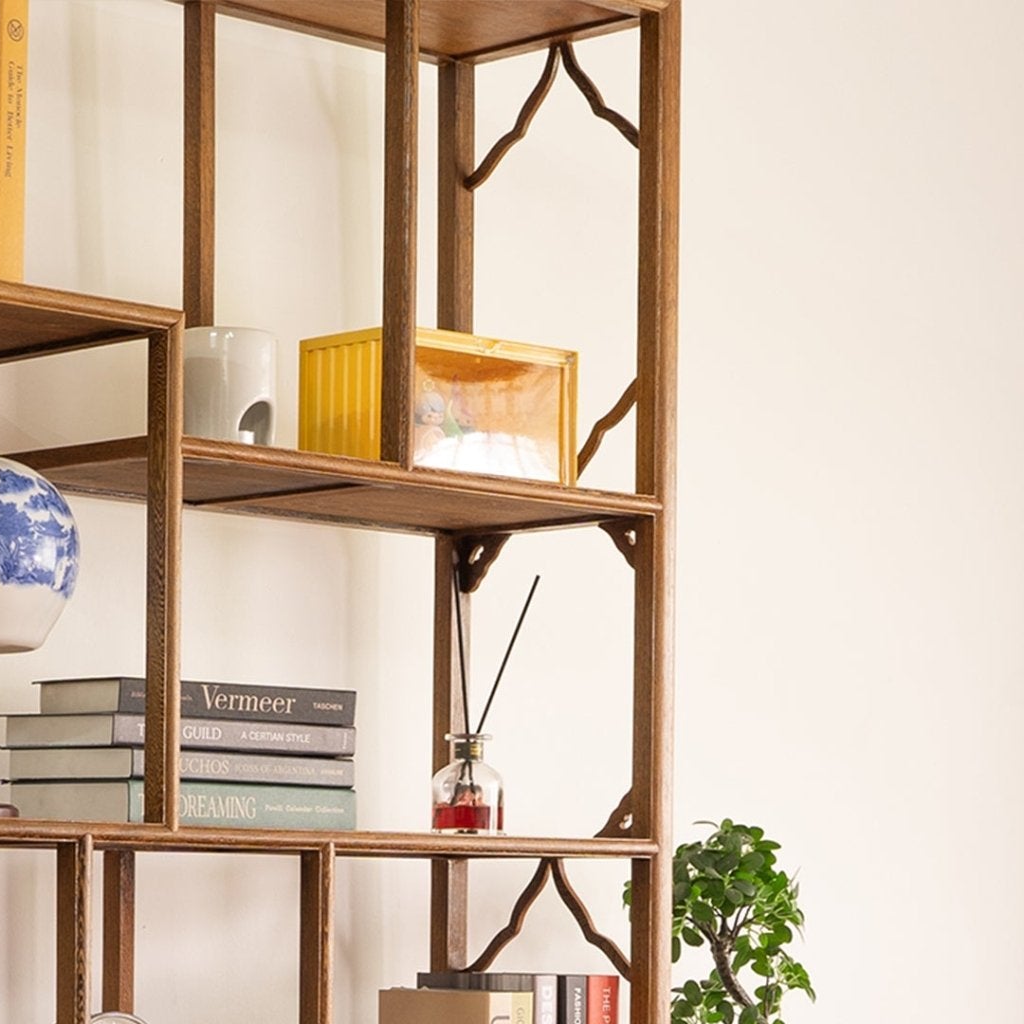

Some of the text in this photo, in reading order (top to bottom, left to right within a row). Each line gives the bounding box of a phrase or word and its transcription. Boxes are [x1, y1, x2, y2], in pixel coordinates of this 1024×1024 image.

[7, 60, 15, 91] Guide
[8, 94, 15, 105] to
[4, 145, 14, 178] Living
[201, 684, 344, 714] Vermeer TASCHEN
[182, 726, 223, 740] GUILD
[240, 731, 248, 740] A
[286, 734, 311, 744] STYLE
[179, 758, 230, 775] UCHOS
[179, 794, 257, 819] DREAMING
[602, 986, 611, 1012] THE
